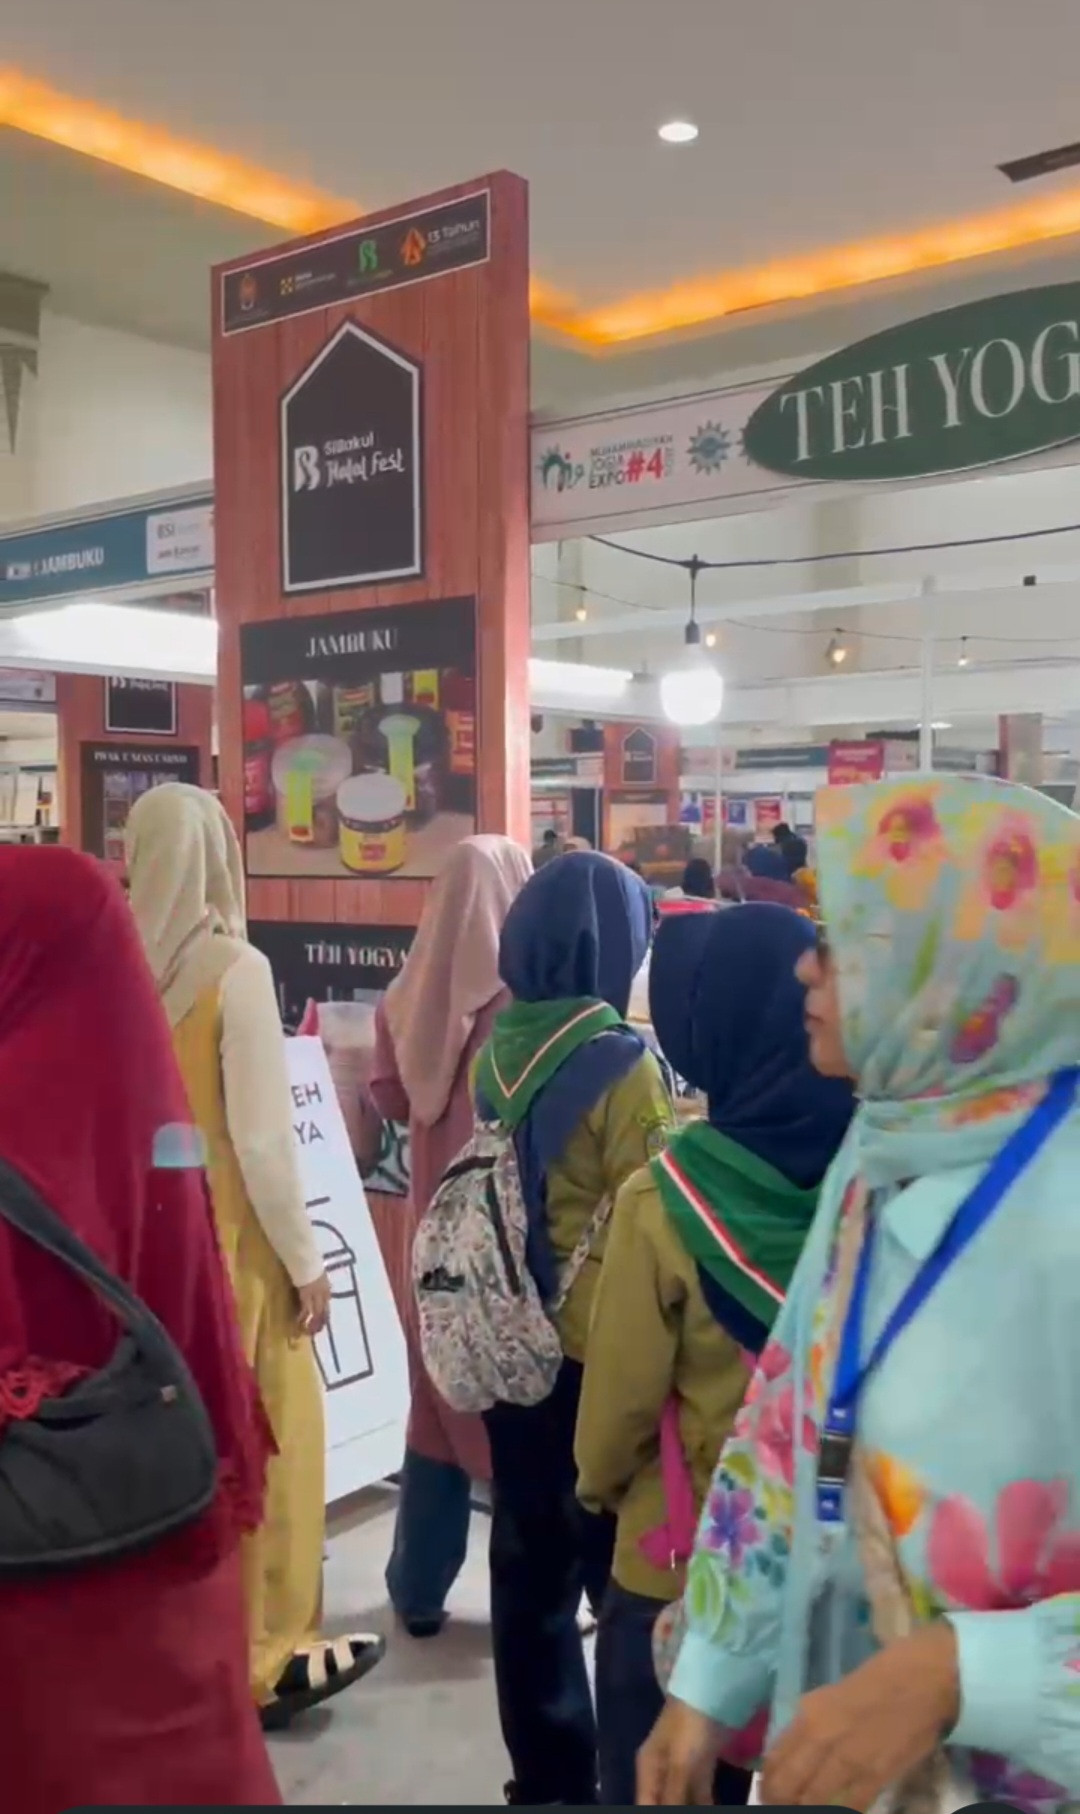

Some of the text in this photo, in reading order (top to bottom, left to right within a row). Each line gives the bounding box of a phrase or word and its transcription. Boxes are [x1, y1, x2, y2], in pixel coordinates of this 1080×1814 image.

[779, 321, 1080, 462] TEH YOG
[325, 448, 406, 487] Halal Fest
[589, 469, 628, 489] EXPO
[625, 448, 665, 483] #4
[40, 546, 104, 575] JAMBUKU
[306, 628, 398, 658] JAMBUKU
[304, 943, 341, 964] TEH
